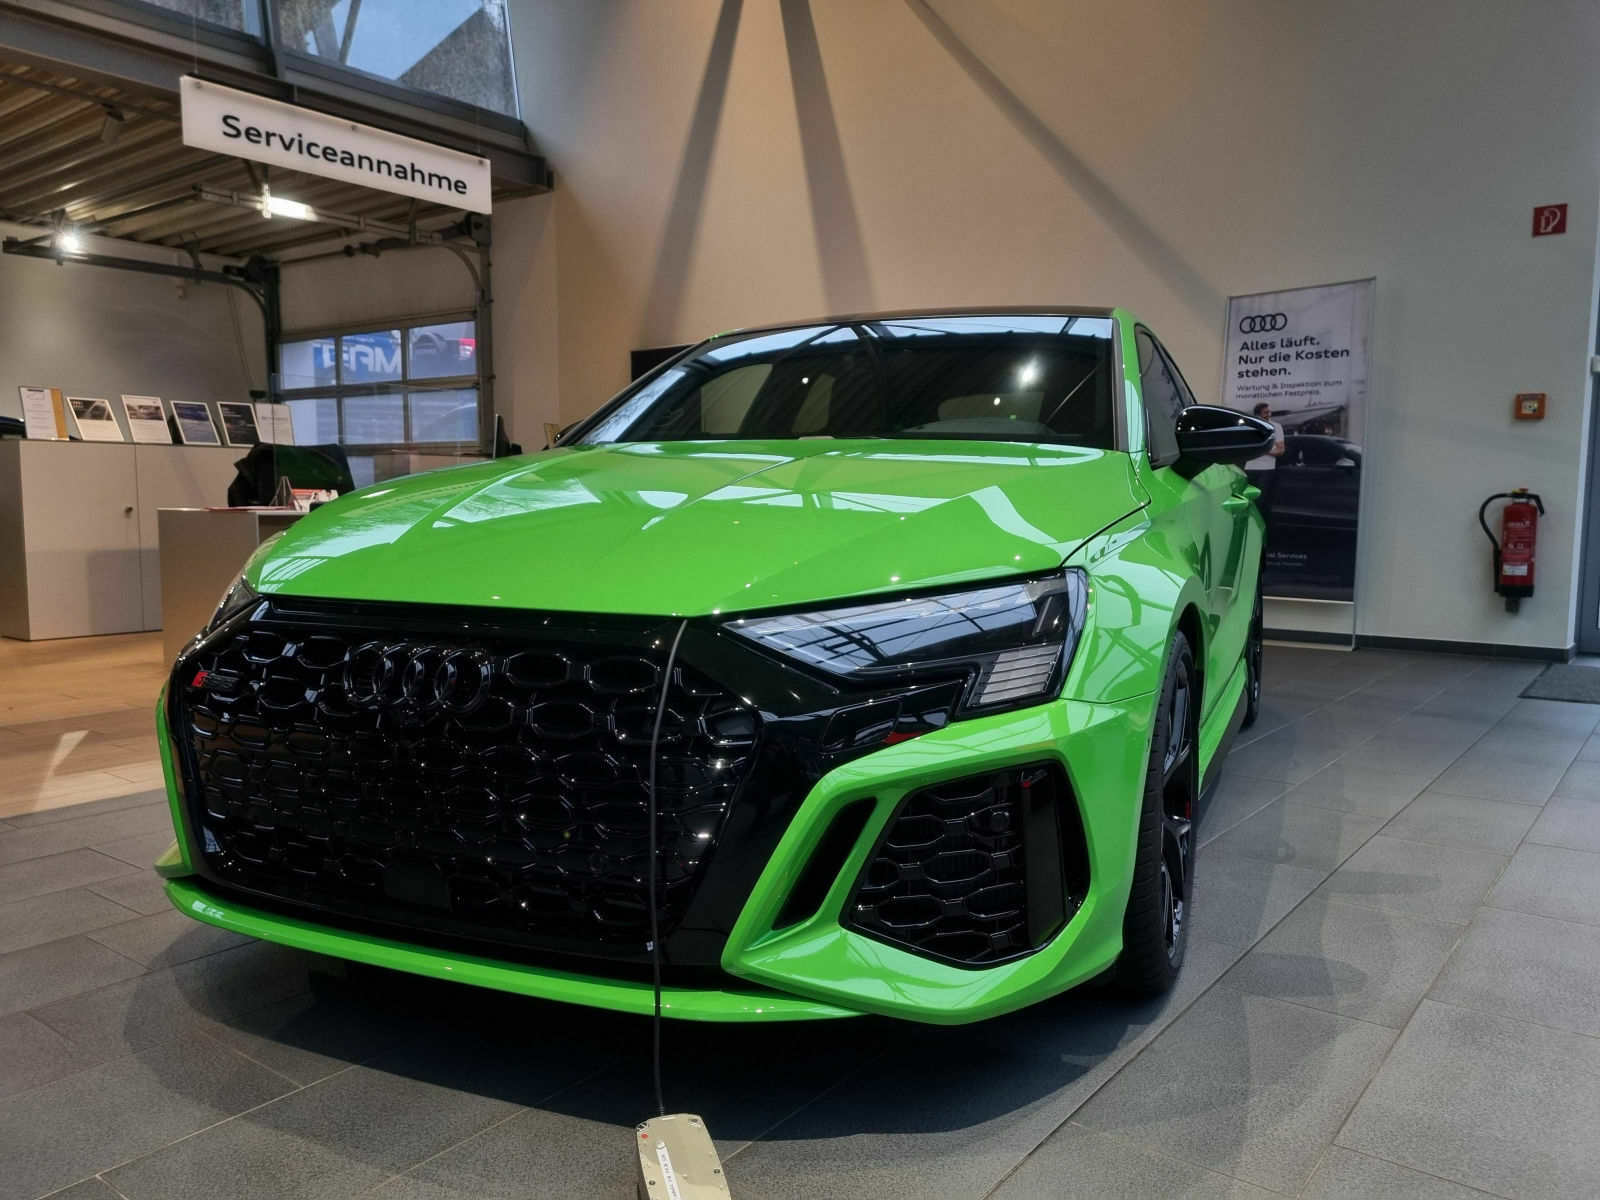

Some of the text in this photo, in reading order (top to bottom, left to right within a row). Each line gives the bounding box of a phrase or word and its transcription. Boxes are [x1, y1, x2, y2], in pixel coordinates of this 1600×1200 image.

[222, 114, 467, 195] Serviceannahme
[1239, 336, 1320, 352] Alles läuft.
[1238, 348, 1350, 365] Nur die Kosten
[1237, 366, 1291, 379] stehen.
[1237, 384, 1270, 392] Wartung
[1280, 381, 1322, 390] Inspektion
[1235, 389, 1321, 399] monatlichen Festpreis.
